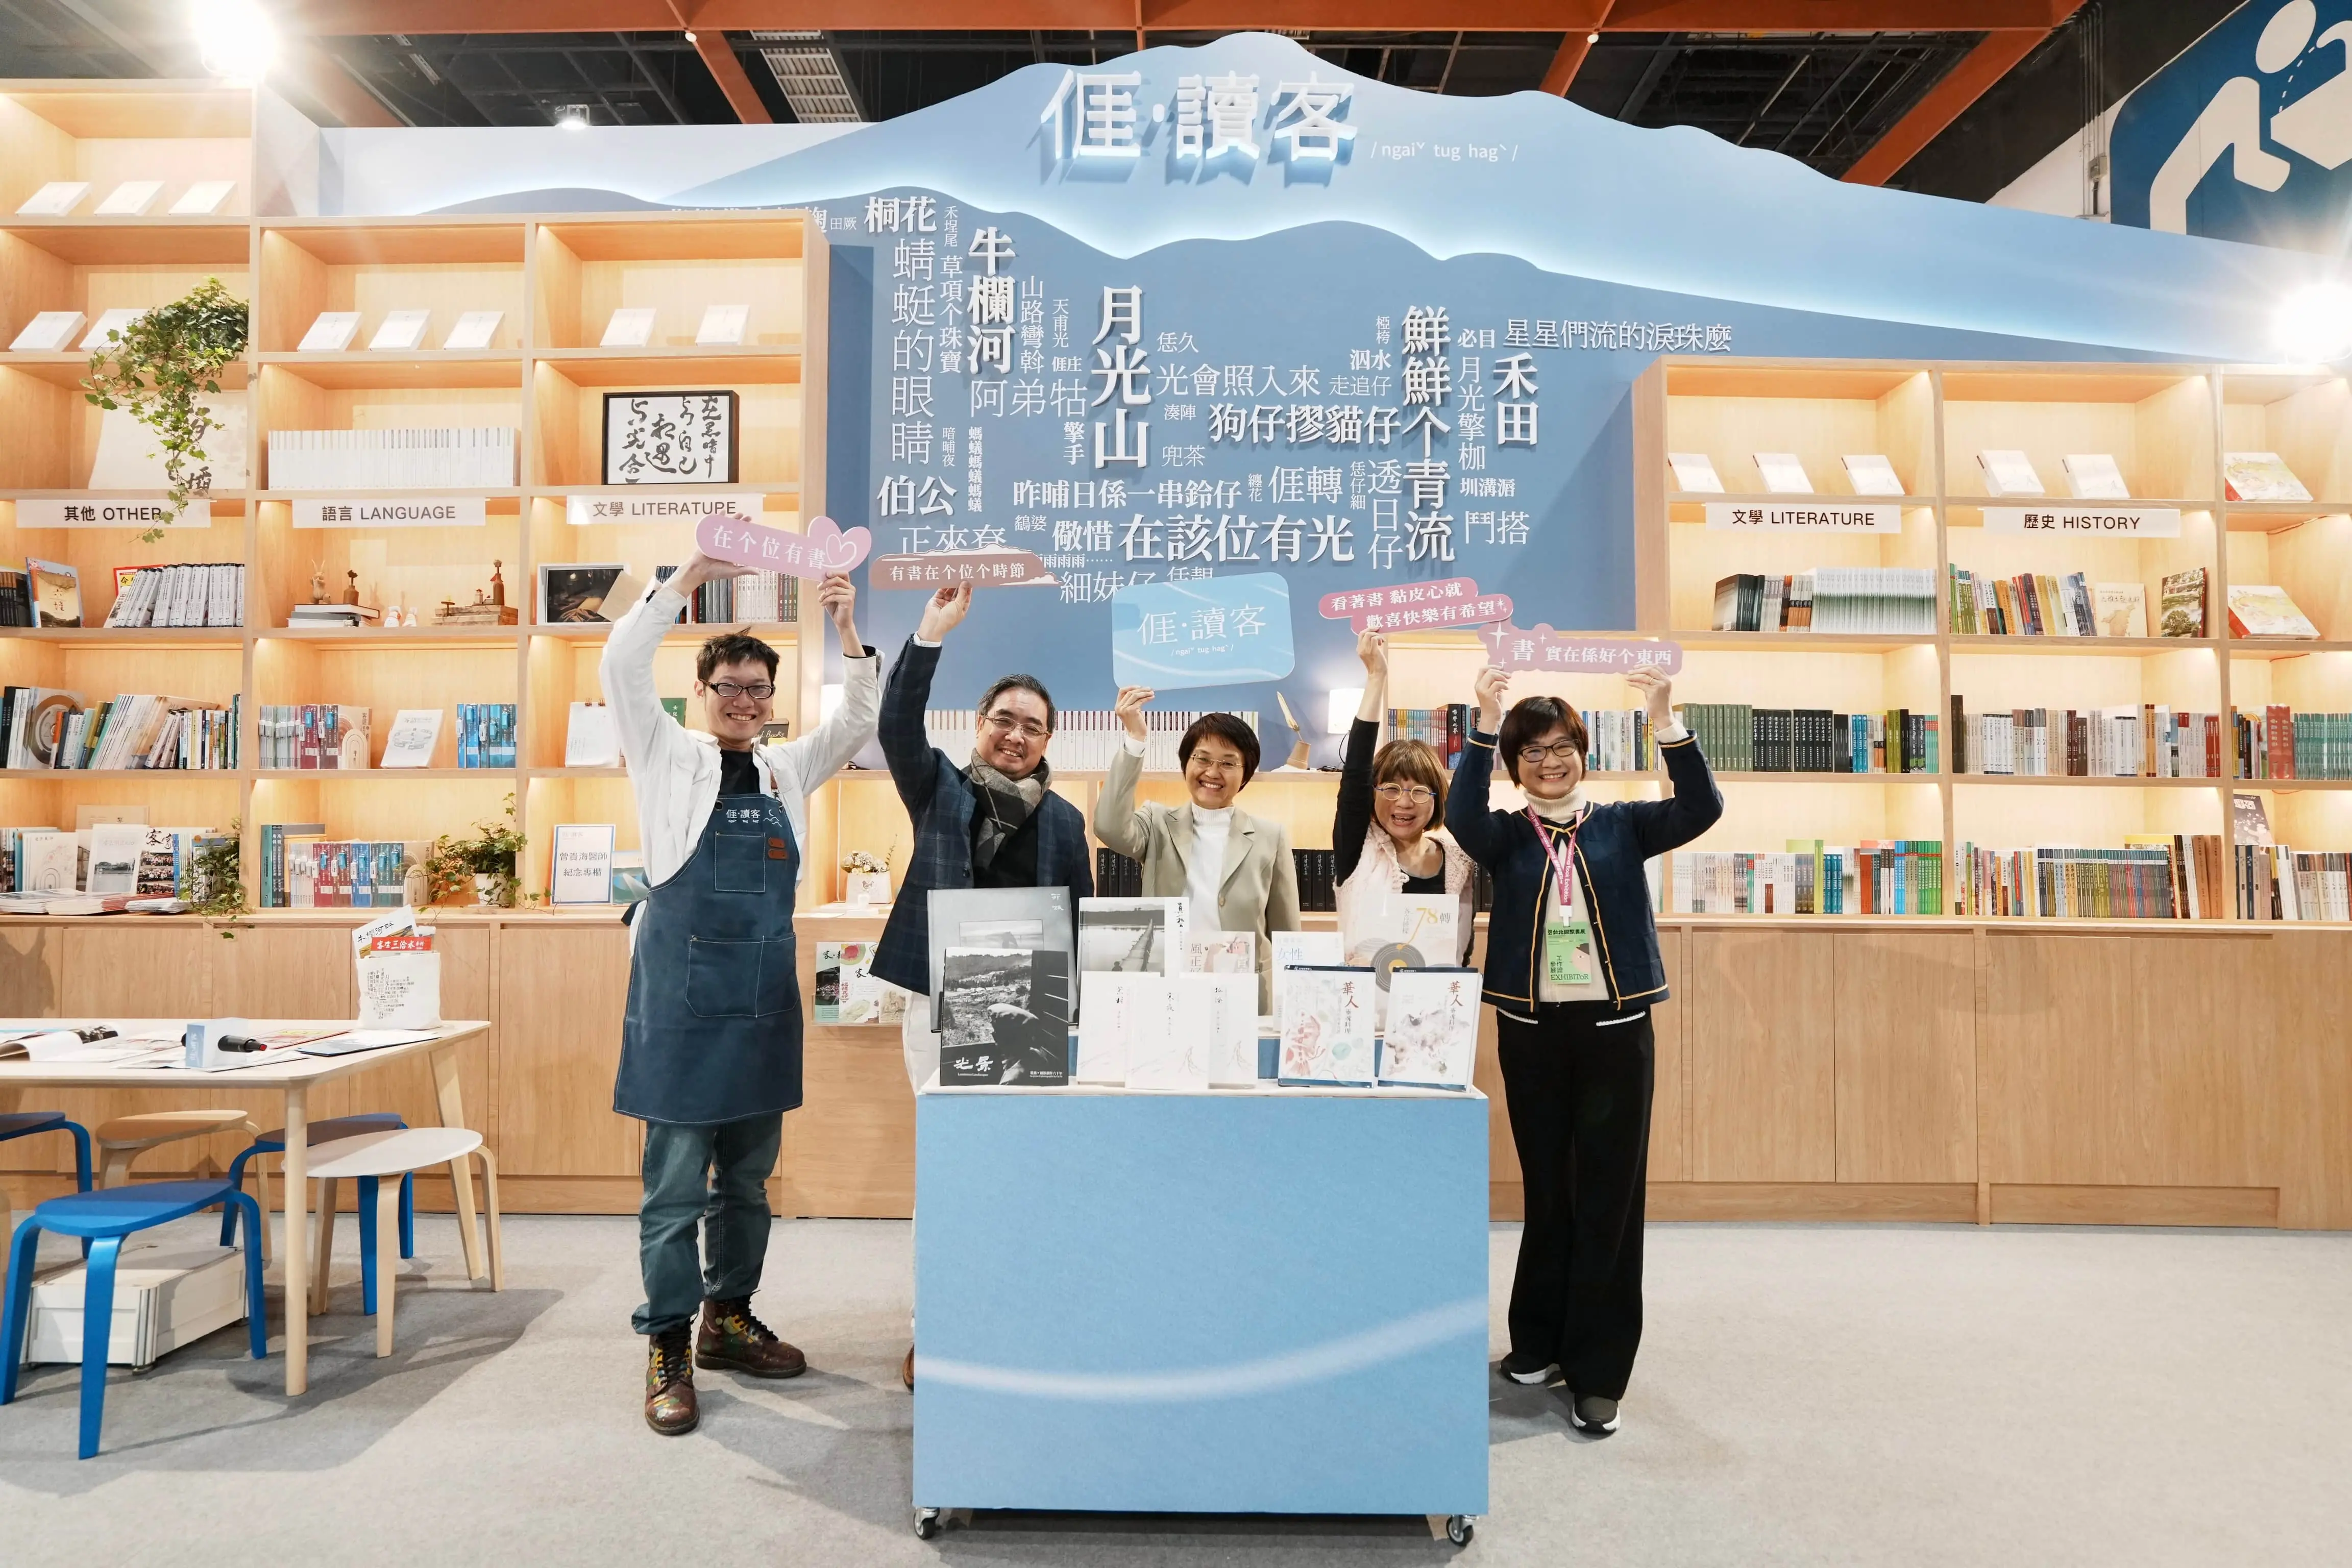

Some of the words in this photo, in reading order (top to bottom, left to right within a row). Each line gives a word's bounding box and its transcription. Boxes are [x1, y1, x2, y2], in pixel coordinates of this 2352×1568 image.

[1434, 144, 1461, 162] tug
[864, 195, 938, 234] 桐花
[944, 205, 958, 247] 禾埕尾
[967, 226, 1017, 374] 牛欄河
[1052, 298, 1069, 348] 天甫光
[1457, 328, 1496, 349] 必目
[1502, 318, 1733, 352] 星星們流的淚珠麼
[891, 238, 937, 464] 蜻蜓的眼睛
[1156, 332, 1199, 353] 恁久
[1350, 349, 1392, 371] 泅水
[1091, 285, 1153, 470] 月光山
[1156, 363, 1321, 397] 光會照入來
[1329, 375, 1392, 397] 走追仔
[970, 378, 1088, 419] 阿弟牯
[1163, 403, 1197, 421] 湊陣
[1457, 356, 1486, 471] 月光擎枷
[1492, 352, 1539, 446] 禾田
[1208, 402, 1402, 445] 狗仔摎貓仔
[1402, 305, 1456, 562] 鮮鮮个青流
[942, 426, 956, 468] 暗晡夜
[1063, 421, 1085, 466] 擎手
[1161, 445, 1206, 467] 兜茶
[967, 426, 983, 512] 螞蟻螞蟻螞蟻
[1350, 461, 1366, 510] 恁仔細
[876, 474, 959, 517] 伯公
[1013, 479, 1242, 510] 昨晡日係一串鈴仔
[1247, 473, 1263, 502] 纏花
[64, 505, 96, 522] 其他
[103, 507, 162, 521] OTHER
[322, 506, 353, 522] 語言
[360, 506, 456, 521] LANGUAGE
[593, 502, 624, 517] 文學
[632, 501, 737, 516] LITERATURE
[1367, 458, 1403, 570] 透日仔
[1732, 509, 1763, 525] 文學
[1771, 511, 1875, 526] LITERATURE
[2024, 514, 2055, 529] 歷史
[2064, 517, 2141, 530] HISTORY
[1117, 513, 1355, 562] 在該位有光
[1464, 510, 1530, 545] 鬥搭
[713, 525, 826, 570] 在个位有書
[889, 562, 1025, 582] 有書在个位个時節
[1331, 591, 1384, 611] 看著書
[1389, 581, 1463, 605] 黏皮心就
[1366, 599, 1496, 630] 歡喜快樂有希望
[1511, 639, 1534, 662] 書
[1545, 645, 1672, 666] 實在係好个東西
[559, 851, 607, 862] 曾貴海醫師
[563, 868, 602, 877] 紀念專櫃
